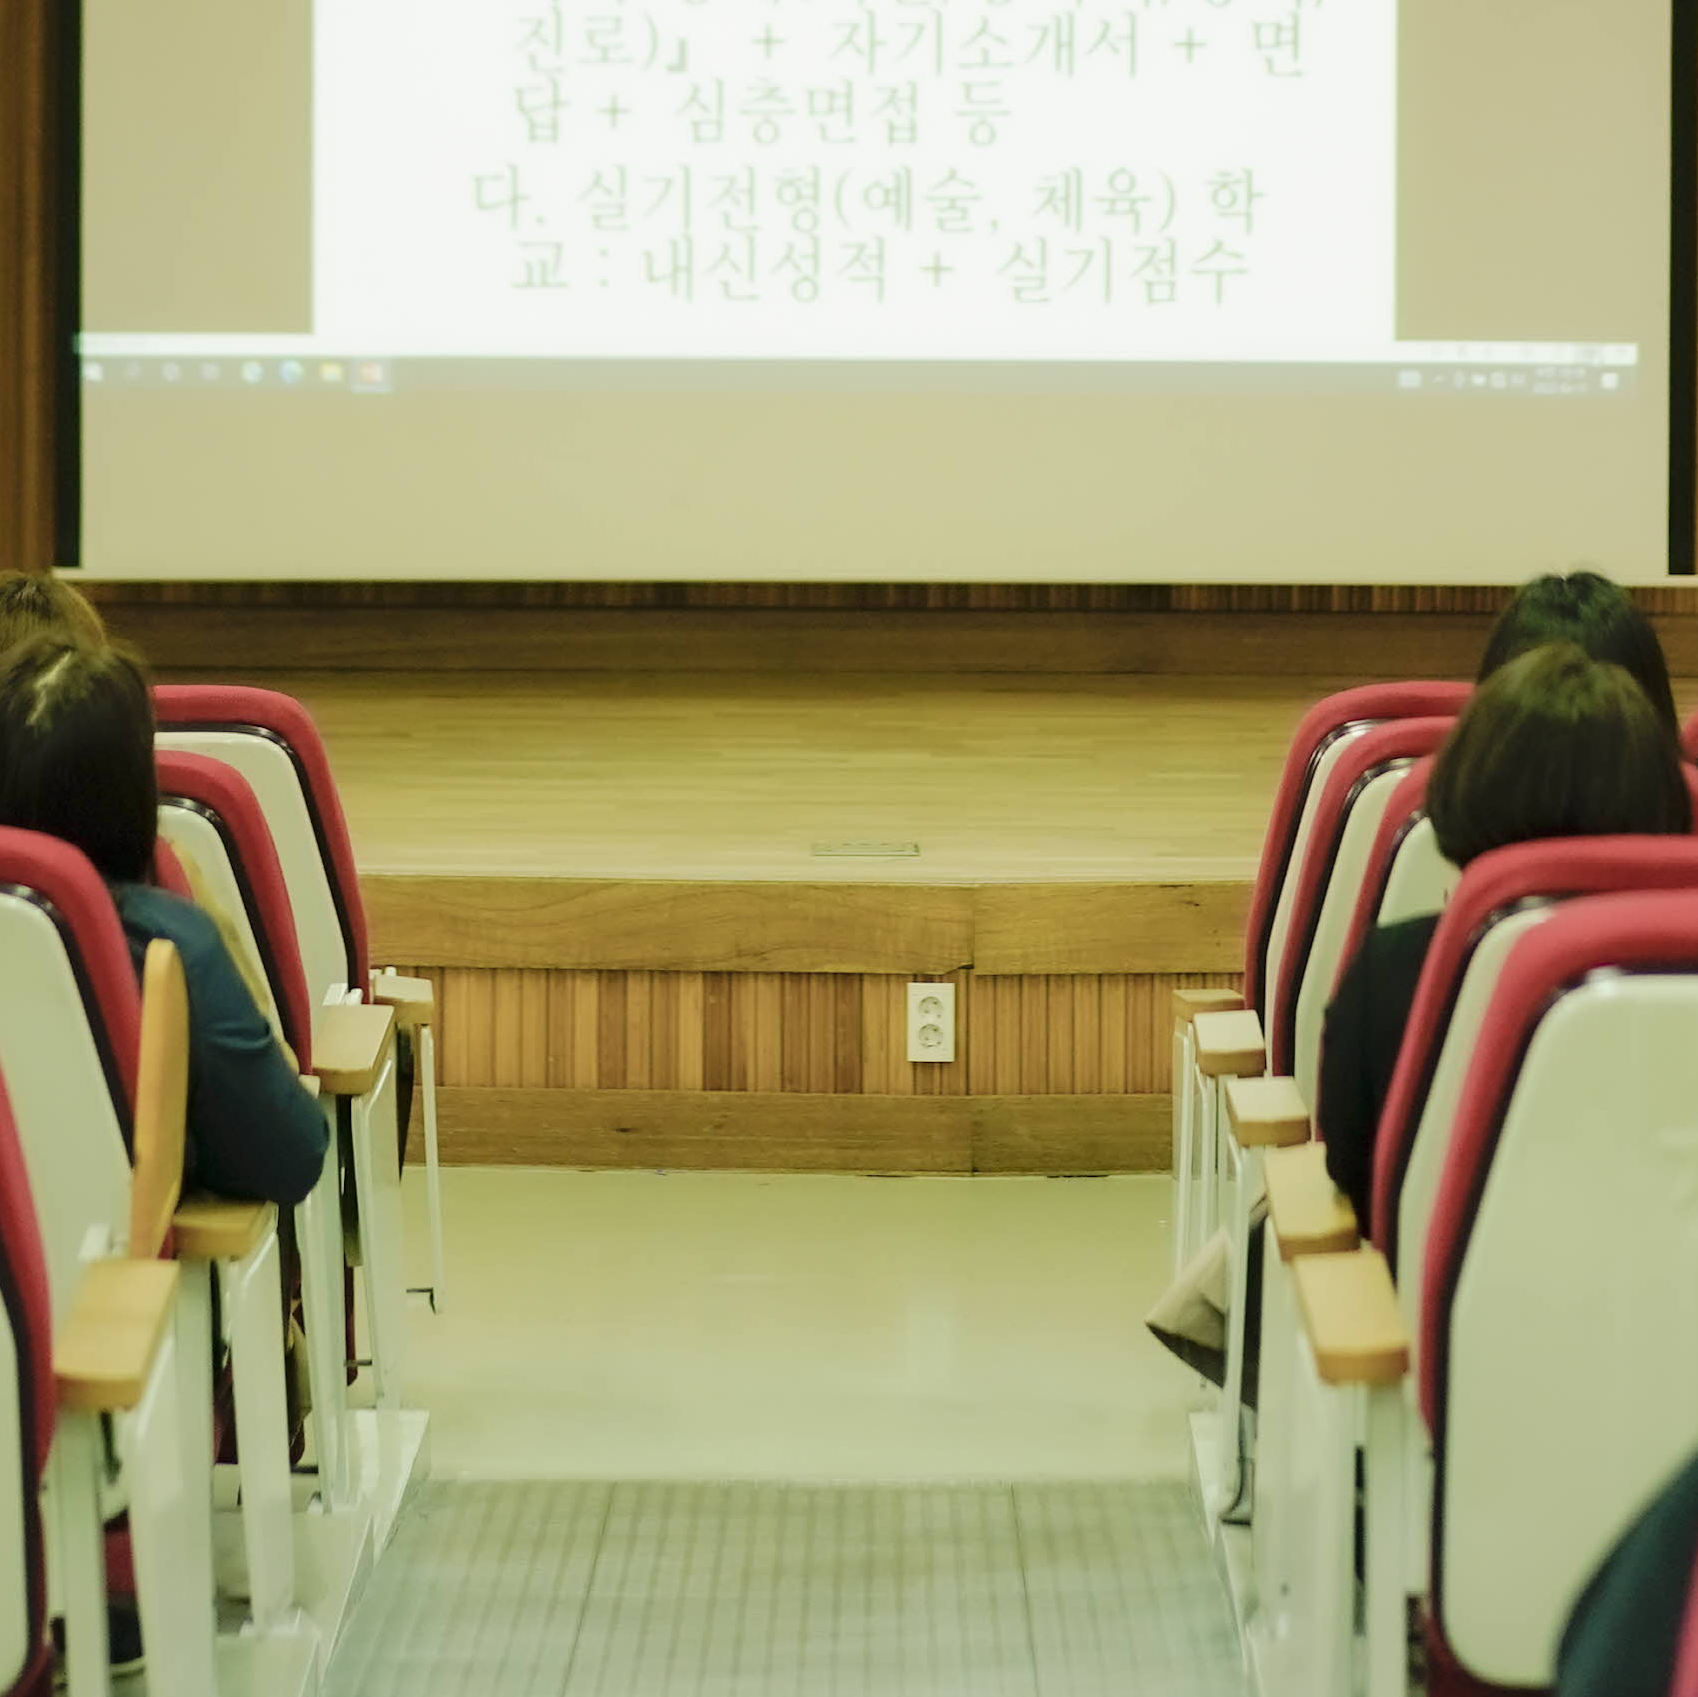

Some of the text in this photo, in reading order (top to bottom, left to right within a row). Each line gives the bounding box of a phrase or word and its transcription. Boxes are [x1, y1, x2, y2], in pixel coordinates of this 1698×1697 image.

[827, 7, 1137, 79] 자기소개서
[1250, 10, 1307, 78] 면
[513, 75, 569, 145] 답
[674, 77, 920, 146] 심층면접
[955, 79, 1012, 147] 등
[471, 162, 549, 232] 다.
[1032, 164, 1180, 236] 체육)
[1207, 164, 1266, 237] 학
[511, 239, 569, 290] 교
[642, 233, 887, 304] 내신성적
[997, 236, 1250, 306] 실기점수
